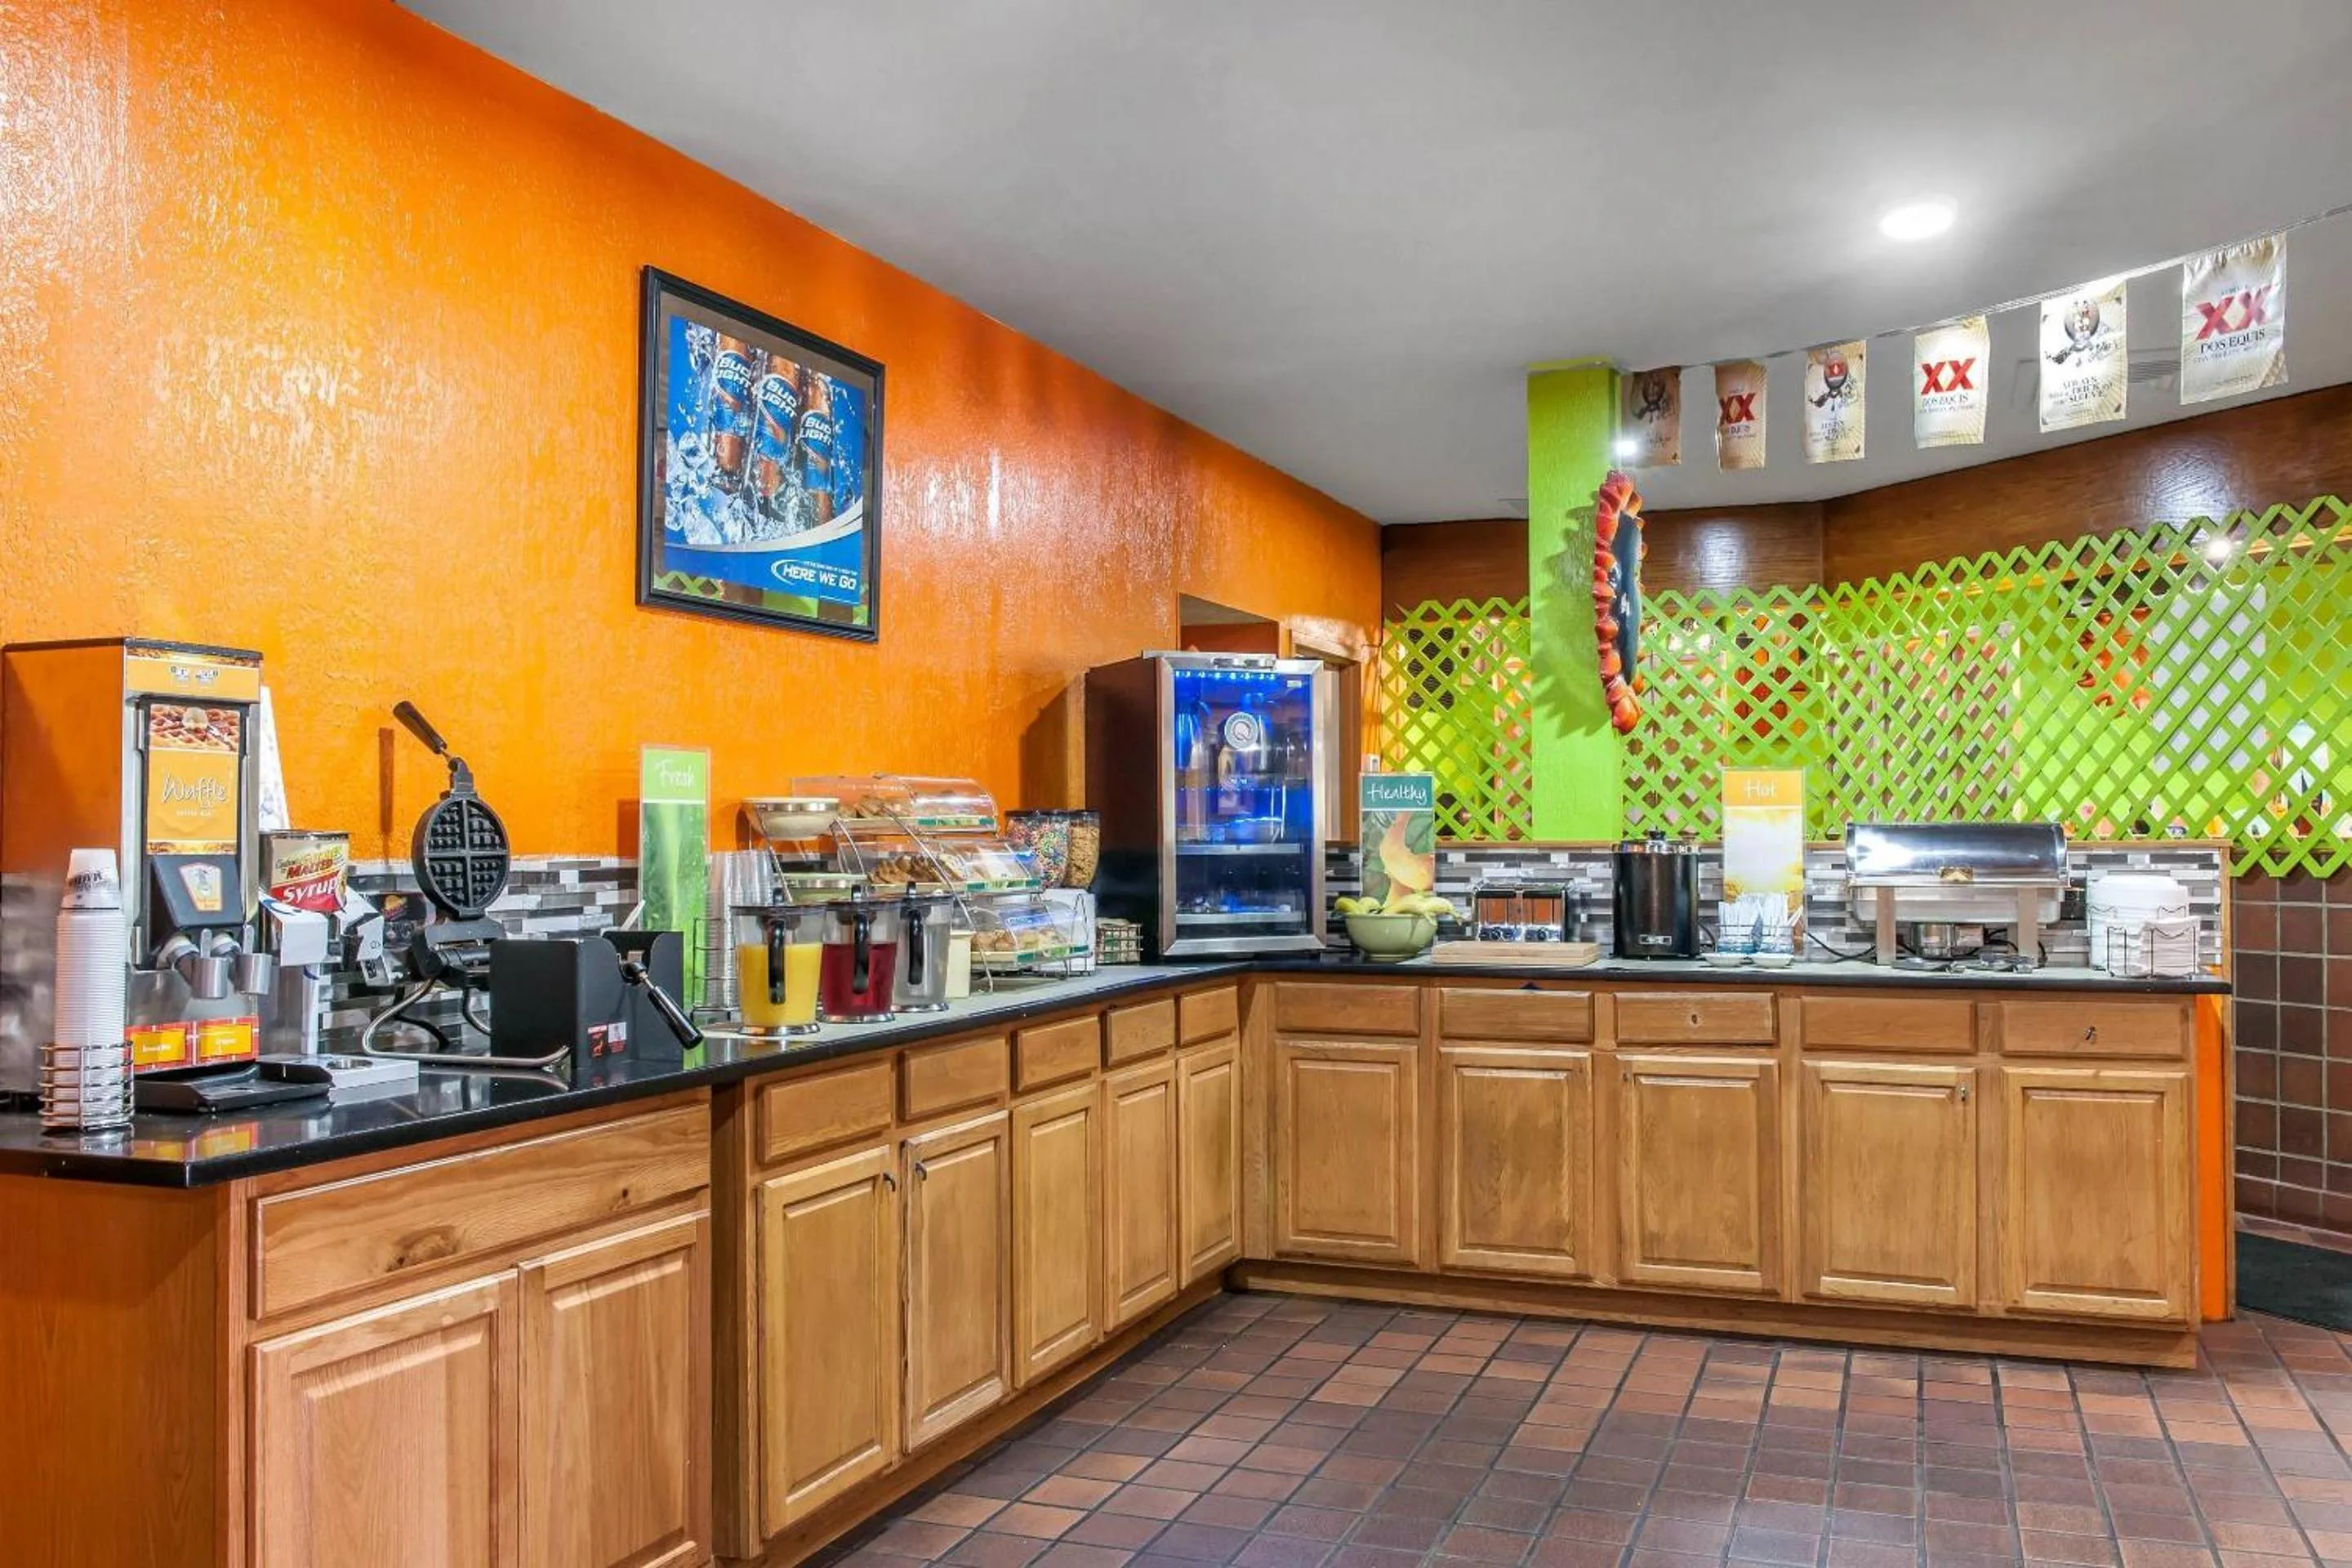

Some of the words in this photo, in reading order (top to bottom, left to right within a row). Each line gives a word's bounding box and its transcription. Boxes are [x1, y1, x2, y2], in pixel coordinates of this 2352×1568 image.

[2194, 283, 2273, 341] XX
[2200, 337, 2226, 354] DOS
[2229, 328, 2266, 349] EQUIS
[719, 356, 750, 379] BUD
[1921, 357, 1976, 395] XX
[766, 379, 797, 408] BUD
[1719, 392, 1757, 426] XX
[800, 428, 832, 446] LIGHT
[804, 416, 832, 434] BUD
[782, 564, 817, 583] HERE
[819, 570, 837, 586] WE
[839, 575, 858, 591] GO
[653, 759, 697, 788] Fresh
[162, 772, 228, 804] Waffle
[1366, 782, 1428, 806] Healthy
[1743, 777, 1778, 799] Hot
[282, 875, 339, 904] Syrup
